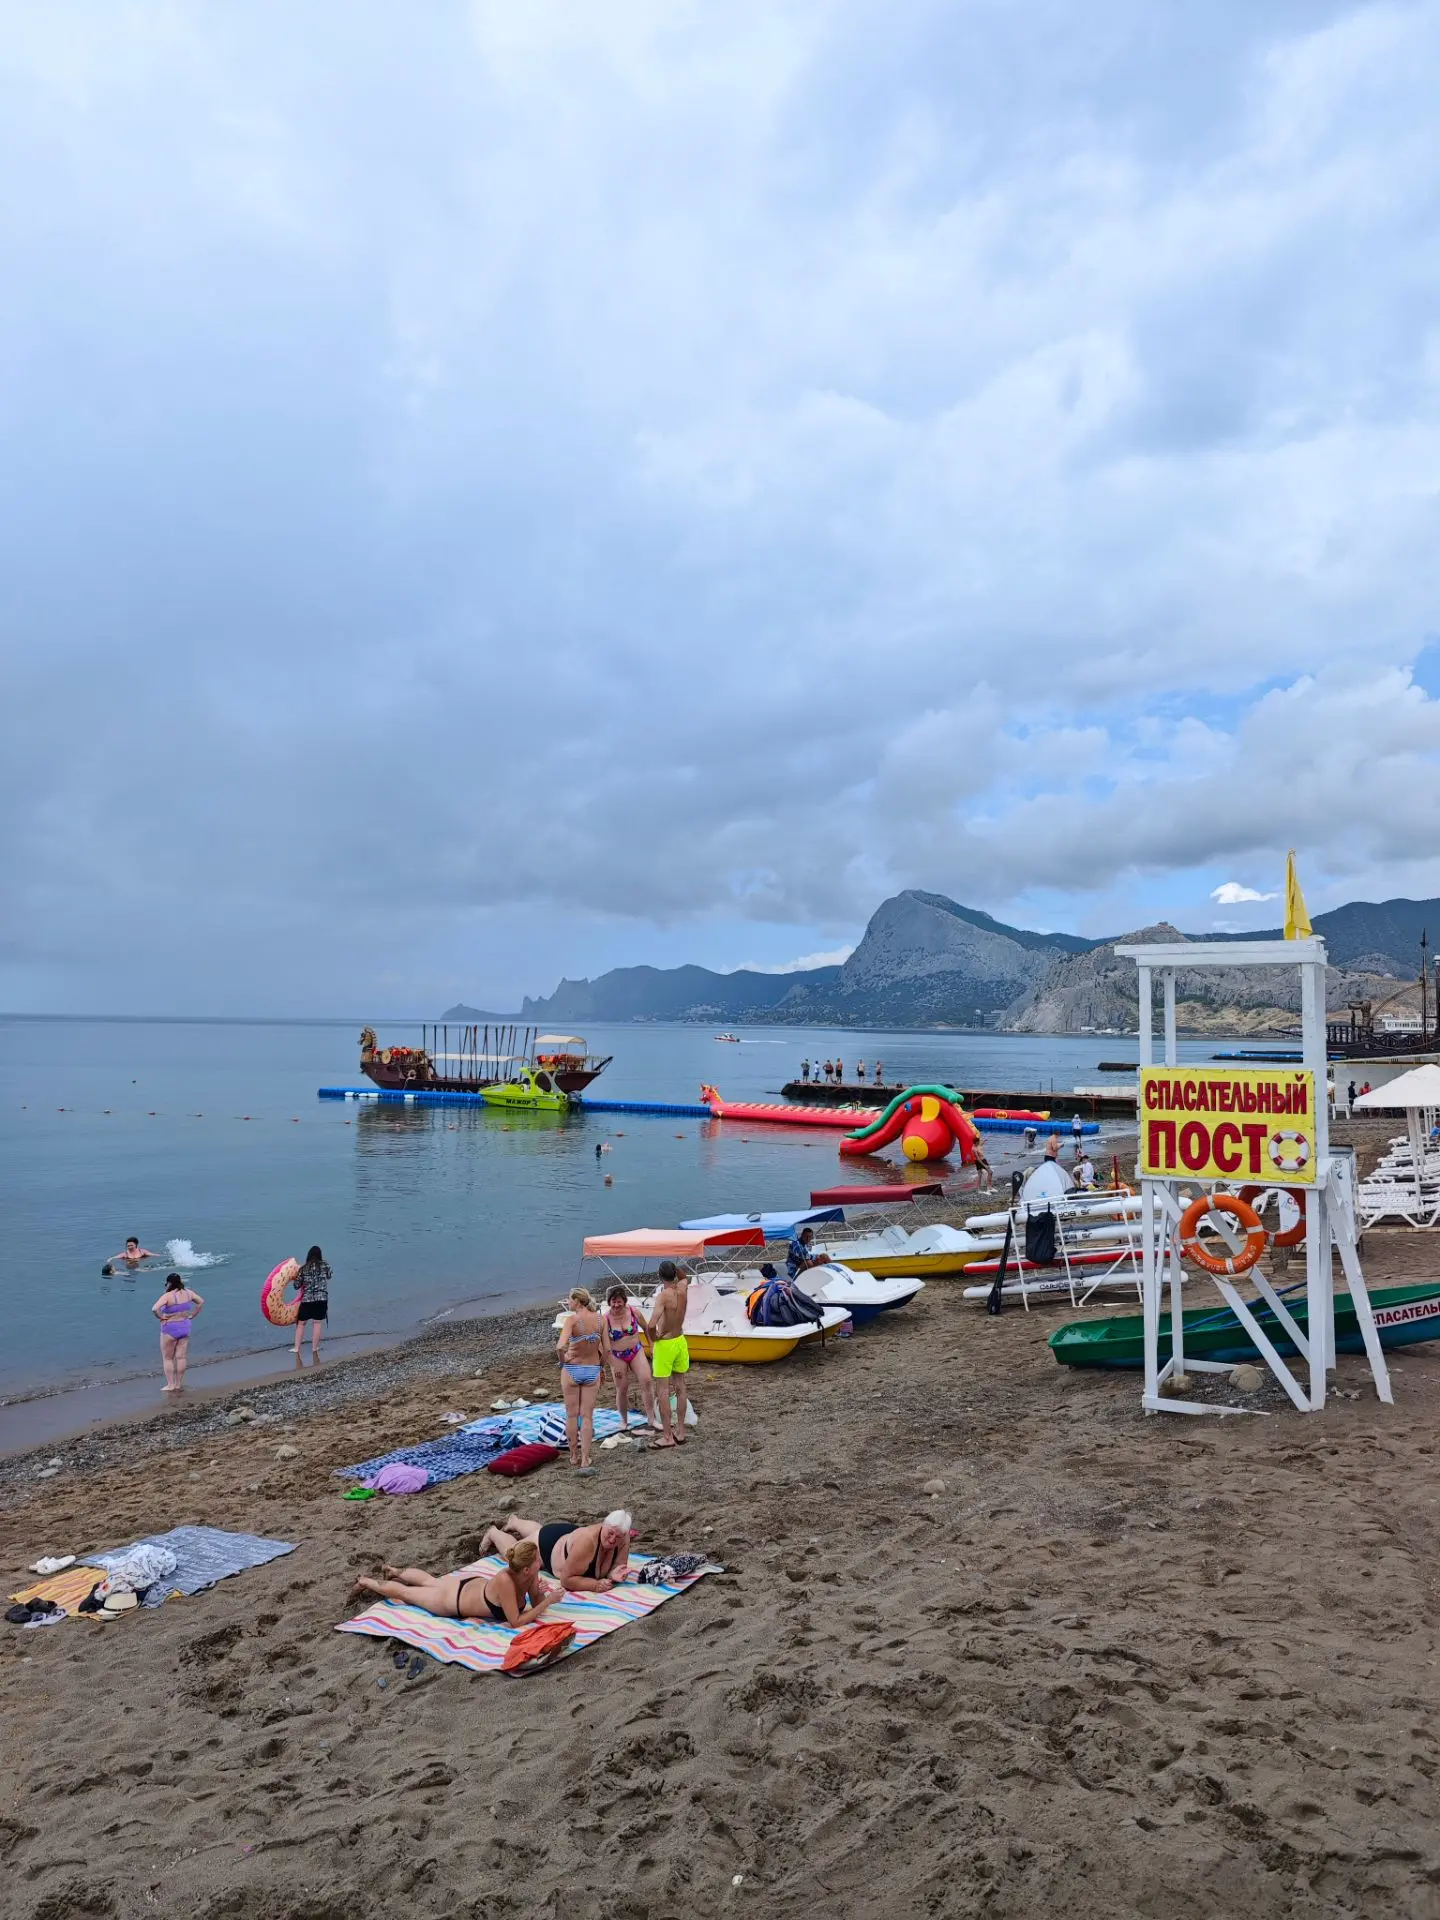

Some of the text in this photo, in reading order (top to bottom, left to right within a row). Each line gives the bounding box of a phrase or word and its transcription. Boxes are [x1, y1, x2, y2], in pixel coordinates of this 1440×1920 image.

[1145, 1073, 1307, 1115] СПАСАТЕЛЬНЫЙ
[1148, 1120, 1267, 1174] ПОСТ
[1373, 1301, 1440, 1325] ПАСАТЕЛЬ
